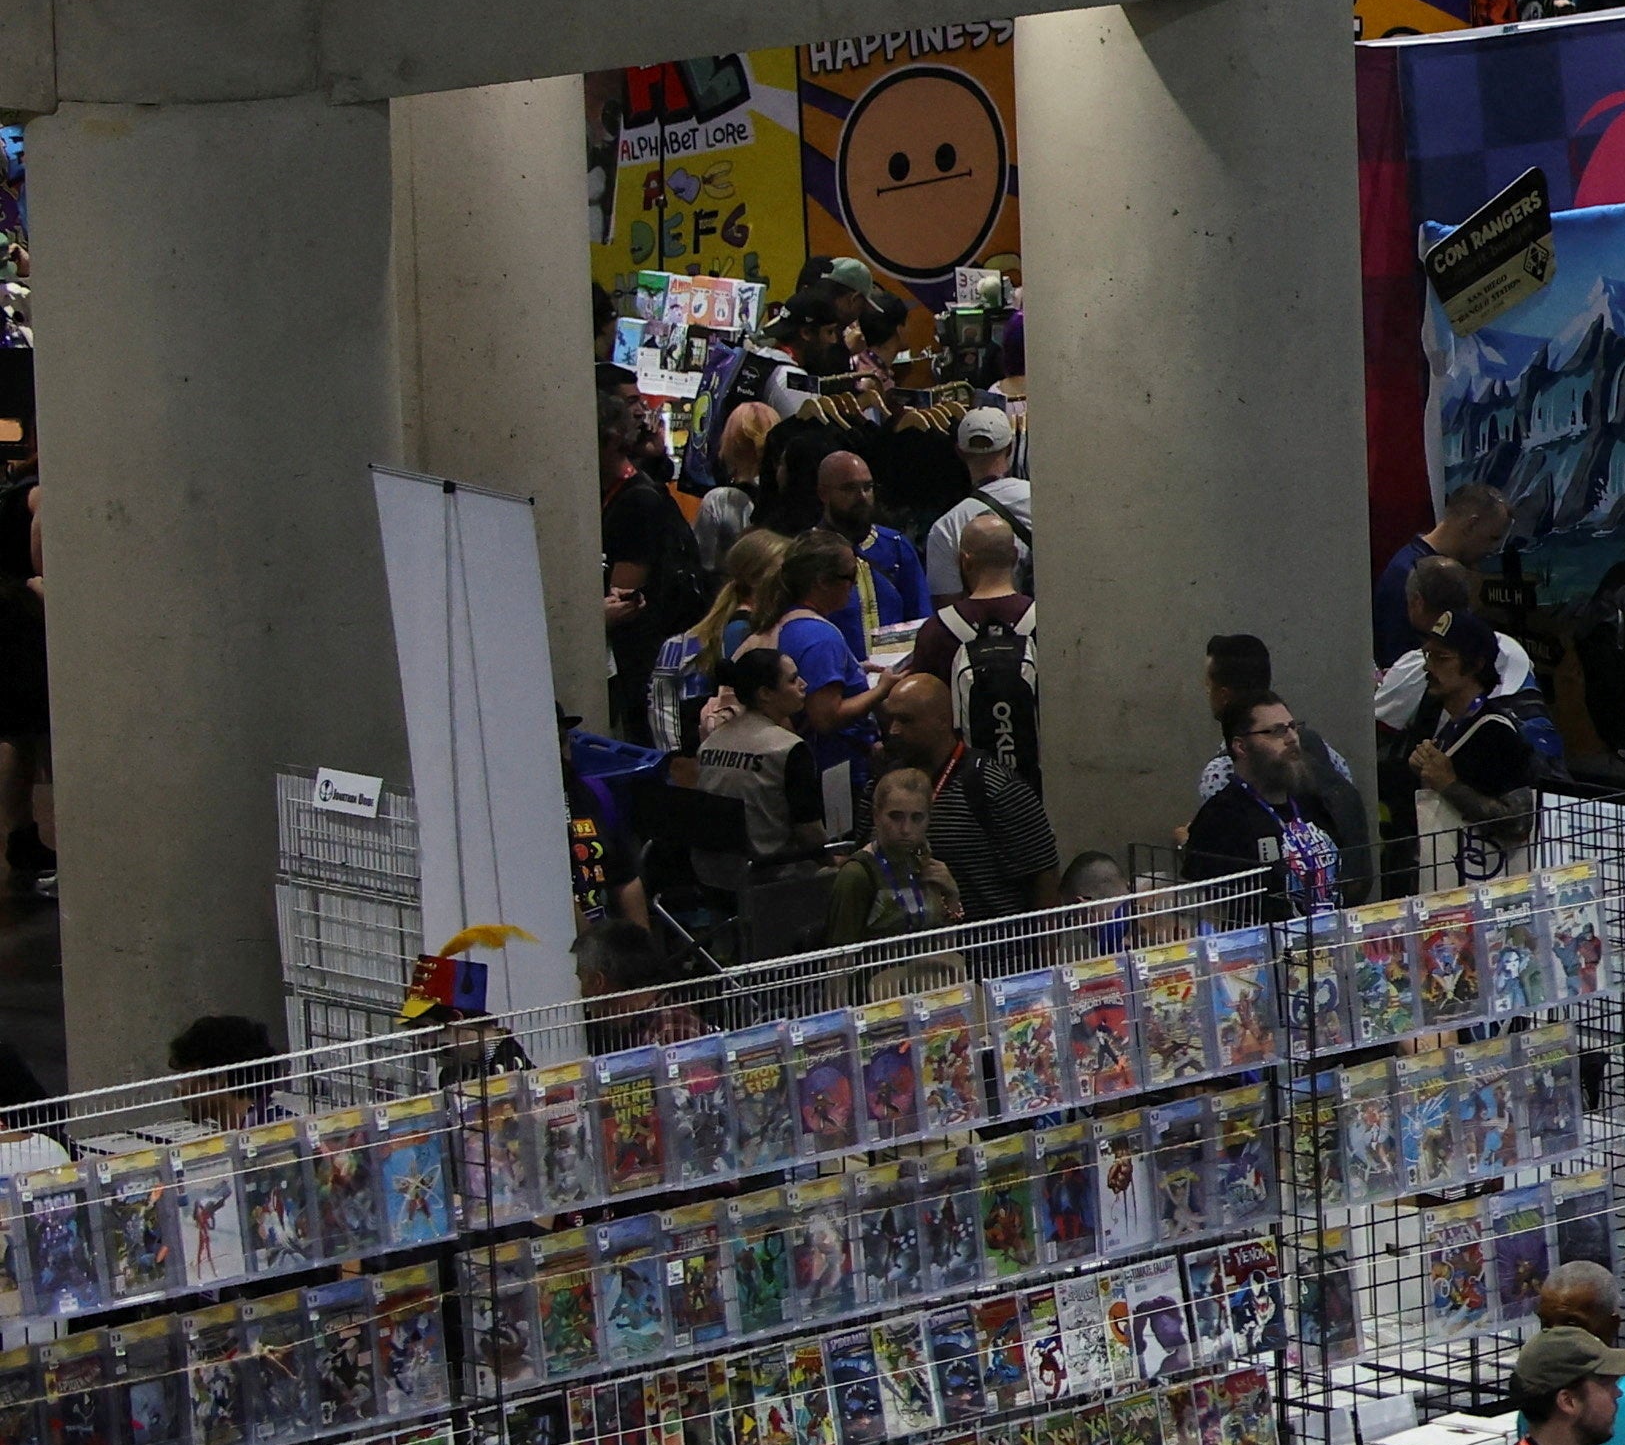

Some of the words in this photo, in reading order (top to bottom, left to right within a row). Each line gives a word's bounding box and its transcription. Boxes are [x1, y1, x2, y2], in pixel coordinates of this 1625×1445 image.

[810, 17, 1018, 75] HAPPINESS
[1433, 241, 1471, 274] CON
[1471, 189, 1543, 251] RANGERS
